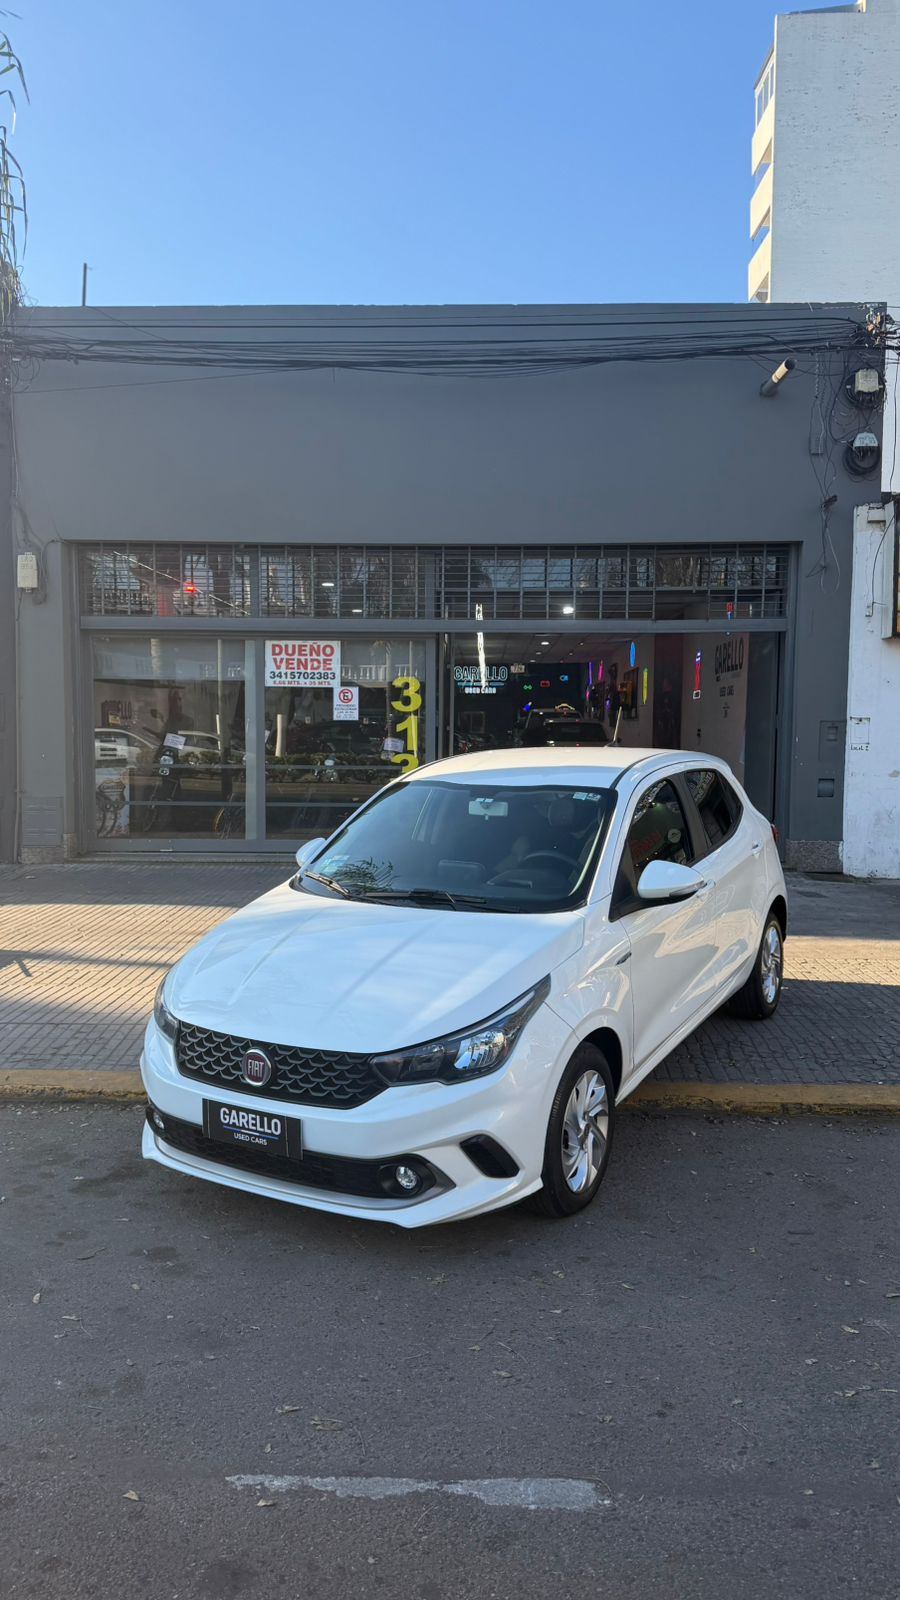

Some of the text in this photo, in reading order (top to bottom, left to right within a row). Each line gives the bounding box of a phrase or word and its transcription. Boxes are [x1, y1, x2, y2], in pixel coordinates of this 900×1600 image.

[271, 641, 335, 657] DUEÑO
[272, 657, 333, 671] VENDE
[269, 671, 336, 680] 3415702383
[453, 665, 508, 681] GARLLO
[247, 1060, 264, 1077] FIAT
[220, 1107, 281, 1136] GARELLO
[233, 1132, 268, 1146] USED CARS
